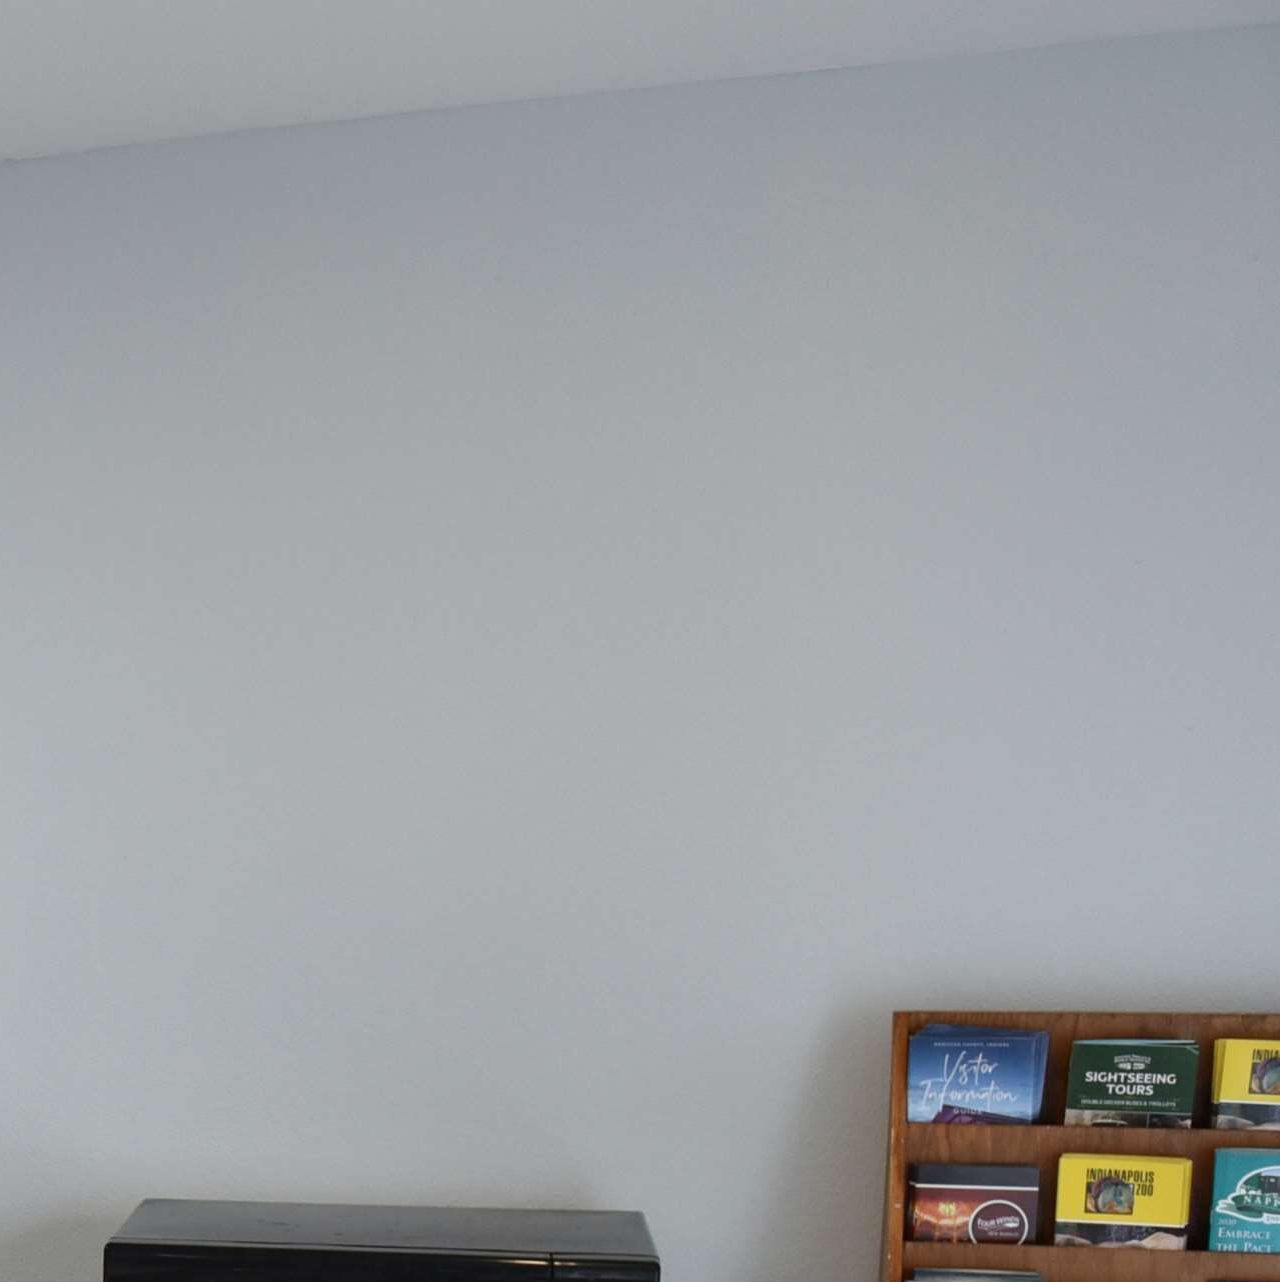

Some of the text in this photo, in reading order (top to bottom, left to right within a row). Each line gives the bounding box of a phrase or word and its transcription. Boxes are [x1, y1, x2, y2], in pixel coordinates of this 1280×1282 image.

[1085, 1071, 1177, 1085] SIGHTSEEING
[1106, 1084, 1154, 1095] TOURS
[1087, 1168, 1154, 1183] INDIANAPOLIS
[1134, 1184, 1154, 1196] ZOO
